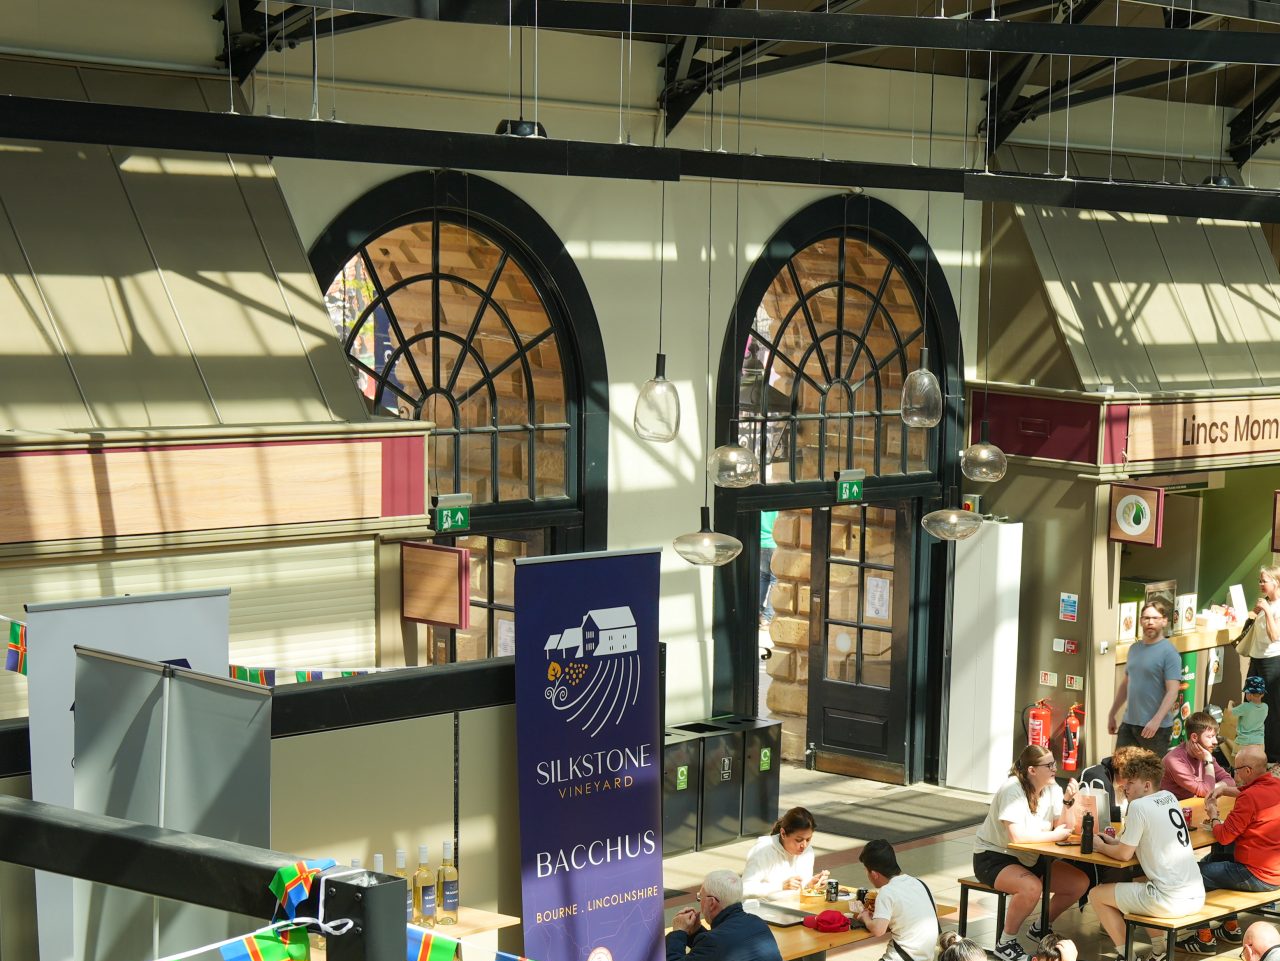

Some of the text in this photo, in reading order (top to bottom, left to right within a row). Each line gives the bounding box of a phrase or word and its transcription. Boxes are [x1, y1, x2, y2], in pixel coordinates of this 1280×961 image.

[1183, 414, 1229, 445] Lincs
[536, 743, 652, 786] SILKSTONE
[558, 775, 634, 799] VINEYARD
[1169, 808, 1190, 847] 9
[536, 830, 655, 878] BACCHUS
[536, 904, 578, 924] BOURNE
[587, 885, 658, 911] LINCOLNSHIRE
